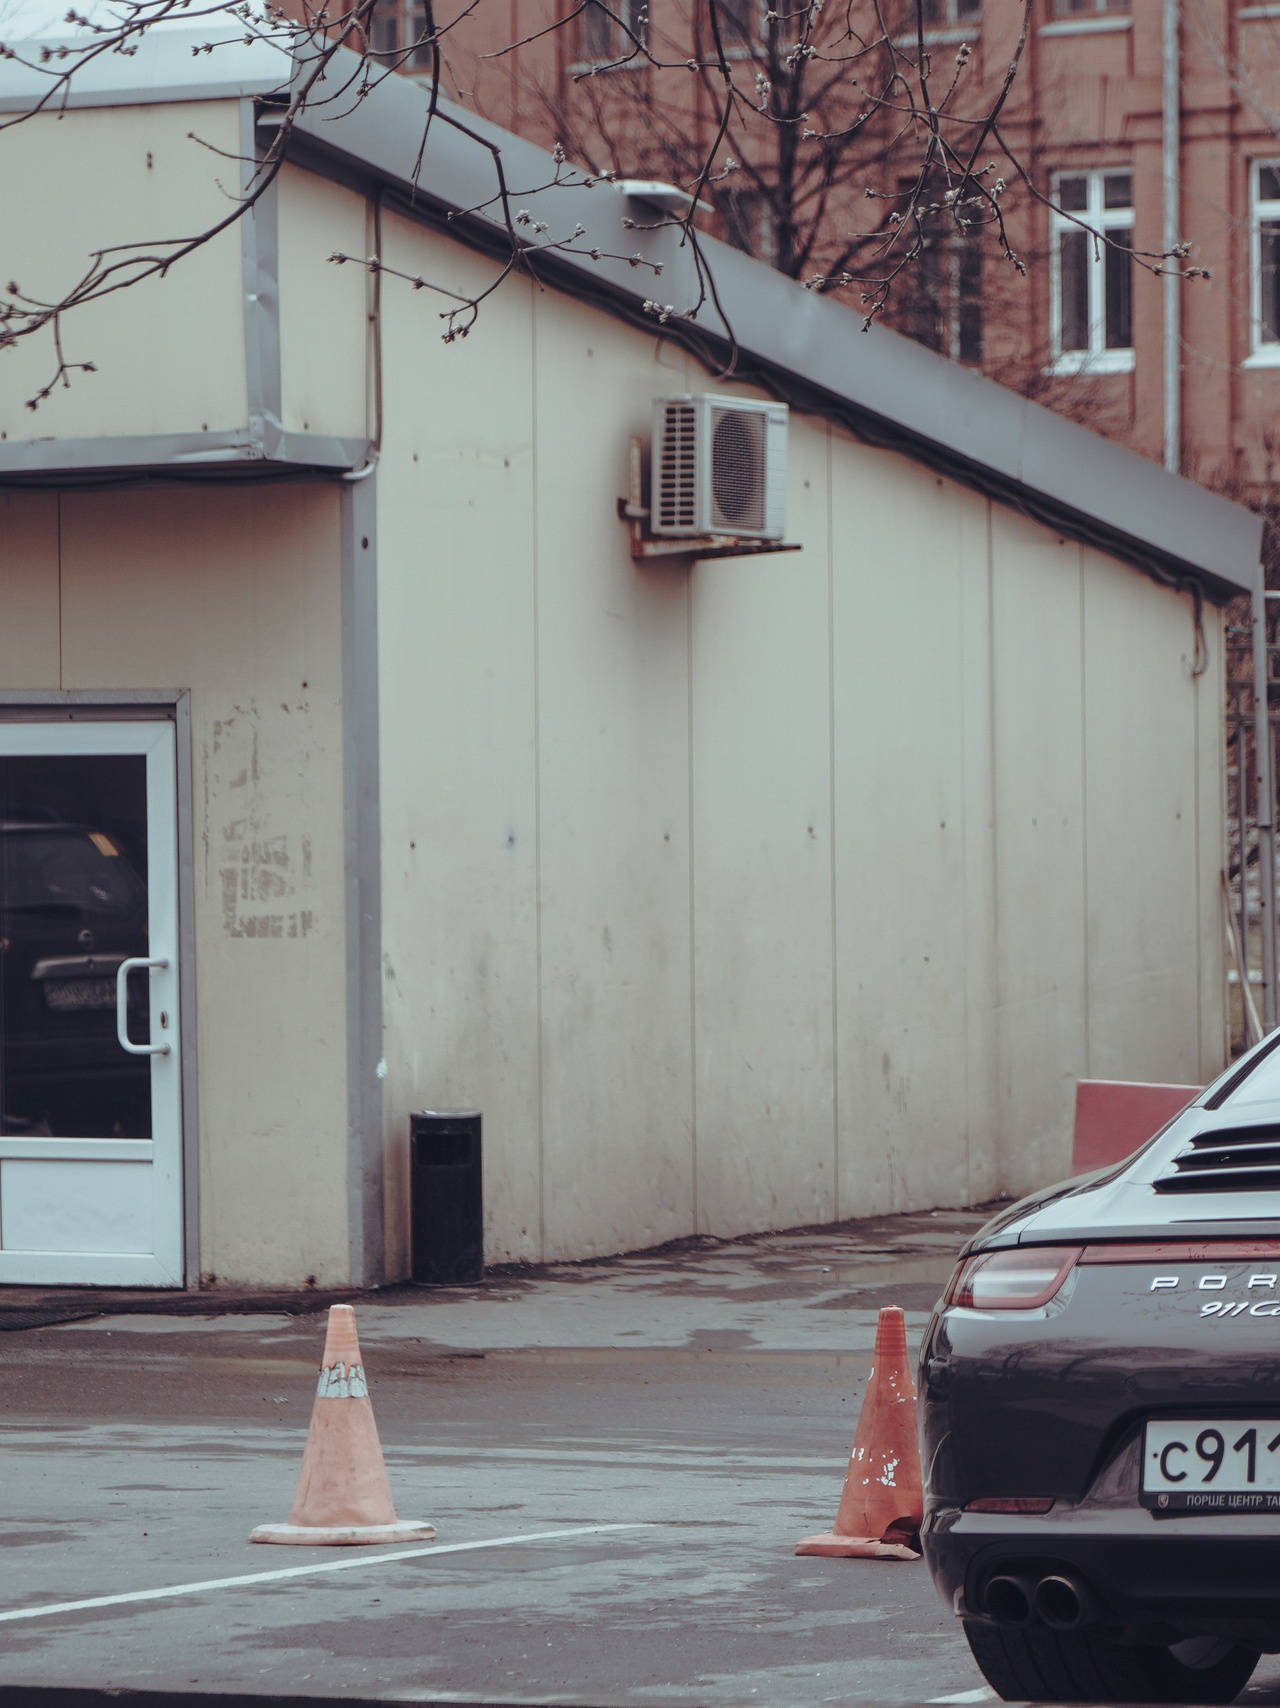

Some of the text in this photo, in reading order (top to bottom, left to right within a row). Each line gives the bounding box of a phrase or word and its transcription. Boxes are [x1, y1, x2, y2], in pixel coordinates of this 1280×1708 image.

[1199, 1300, 1250, 1318] 911
[1186, 1494, 1226, 1507] ПОРШЕ
[1228, 1494, 1263, 1508] ЦЕНТР
